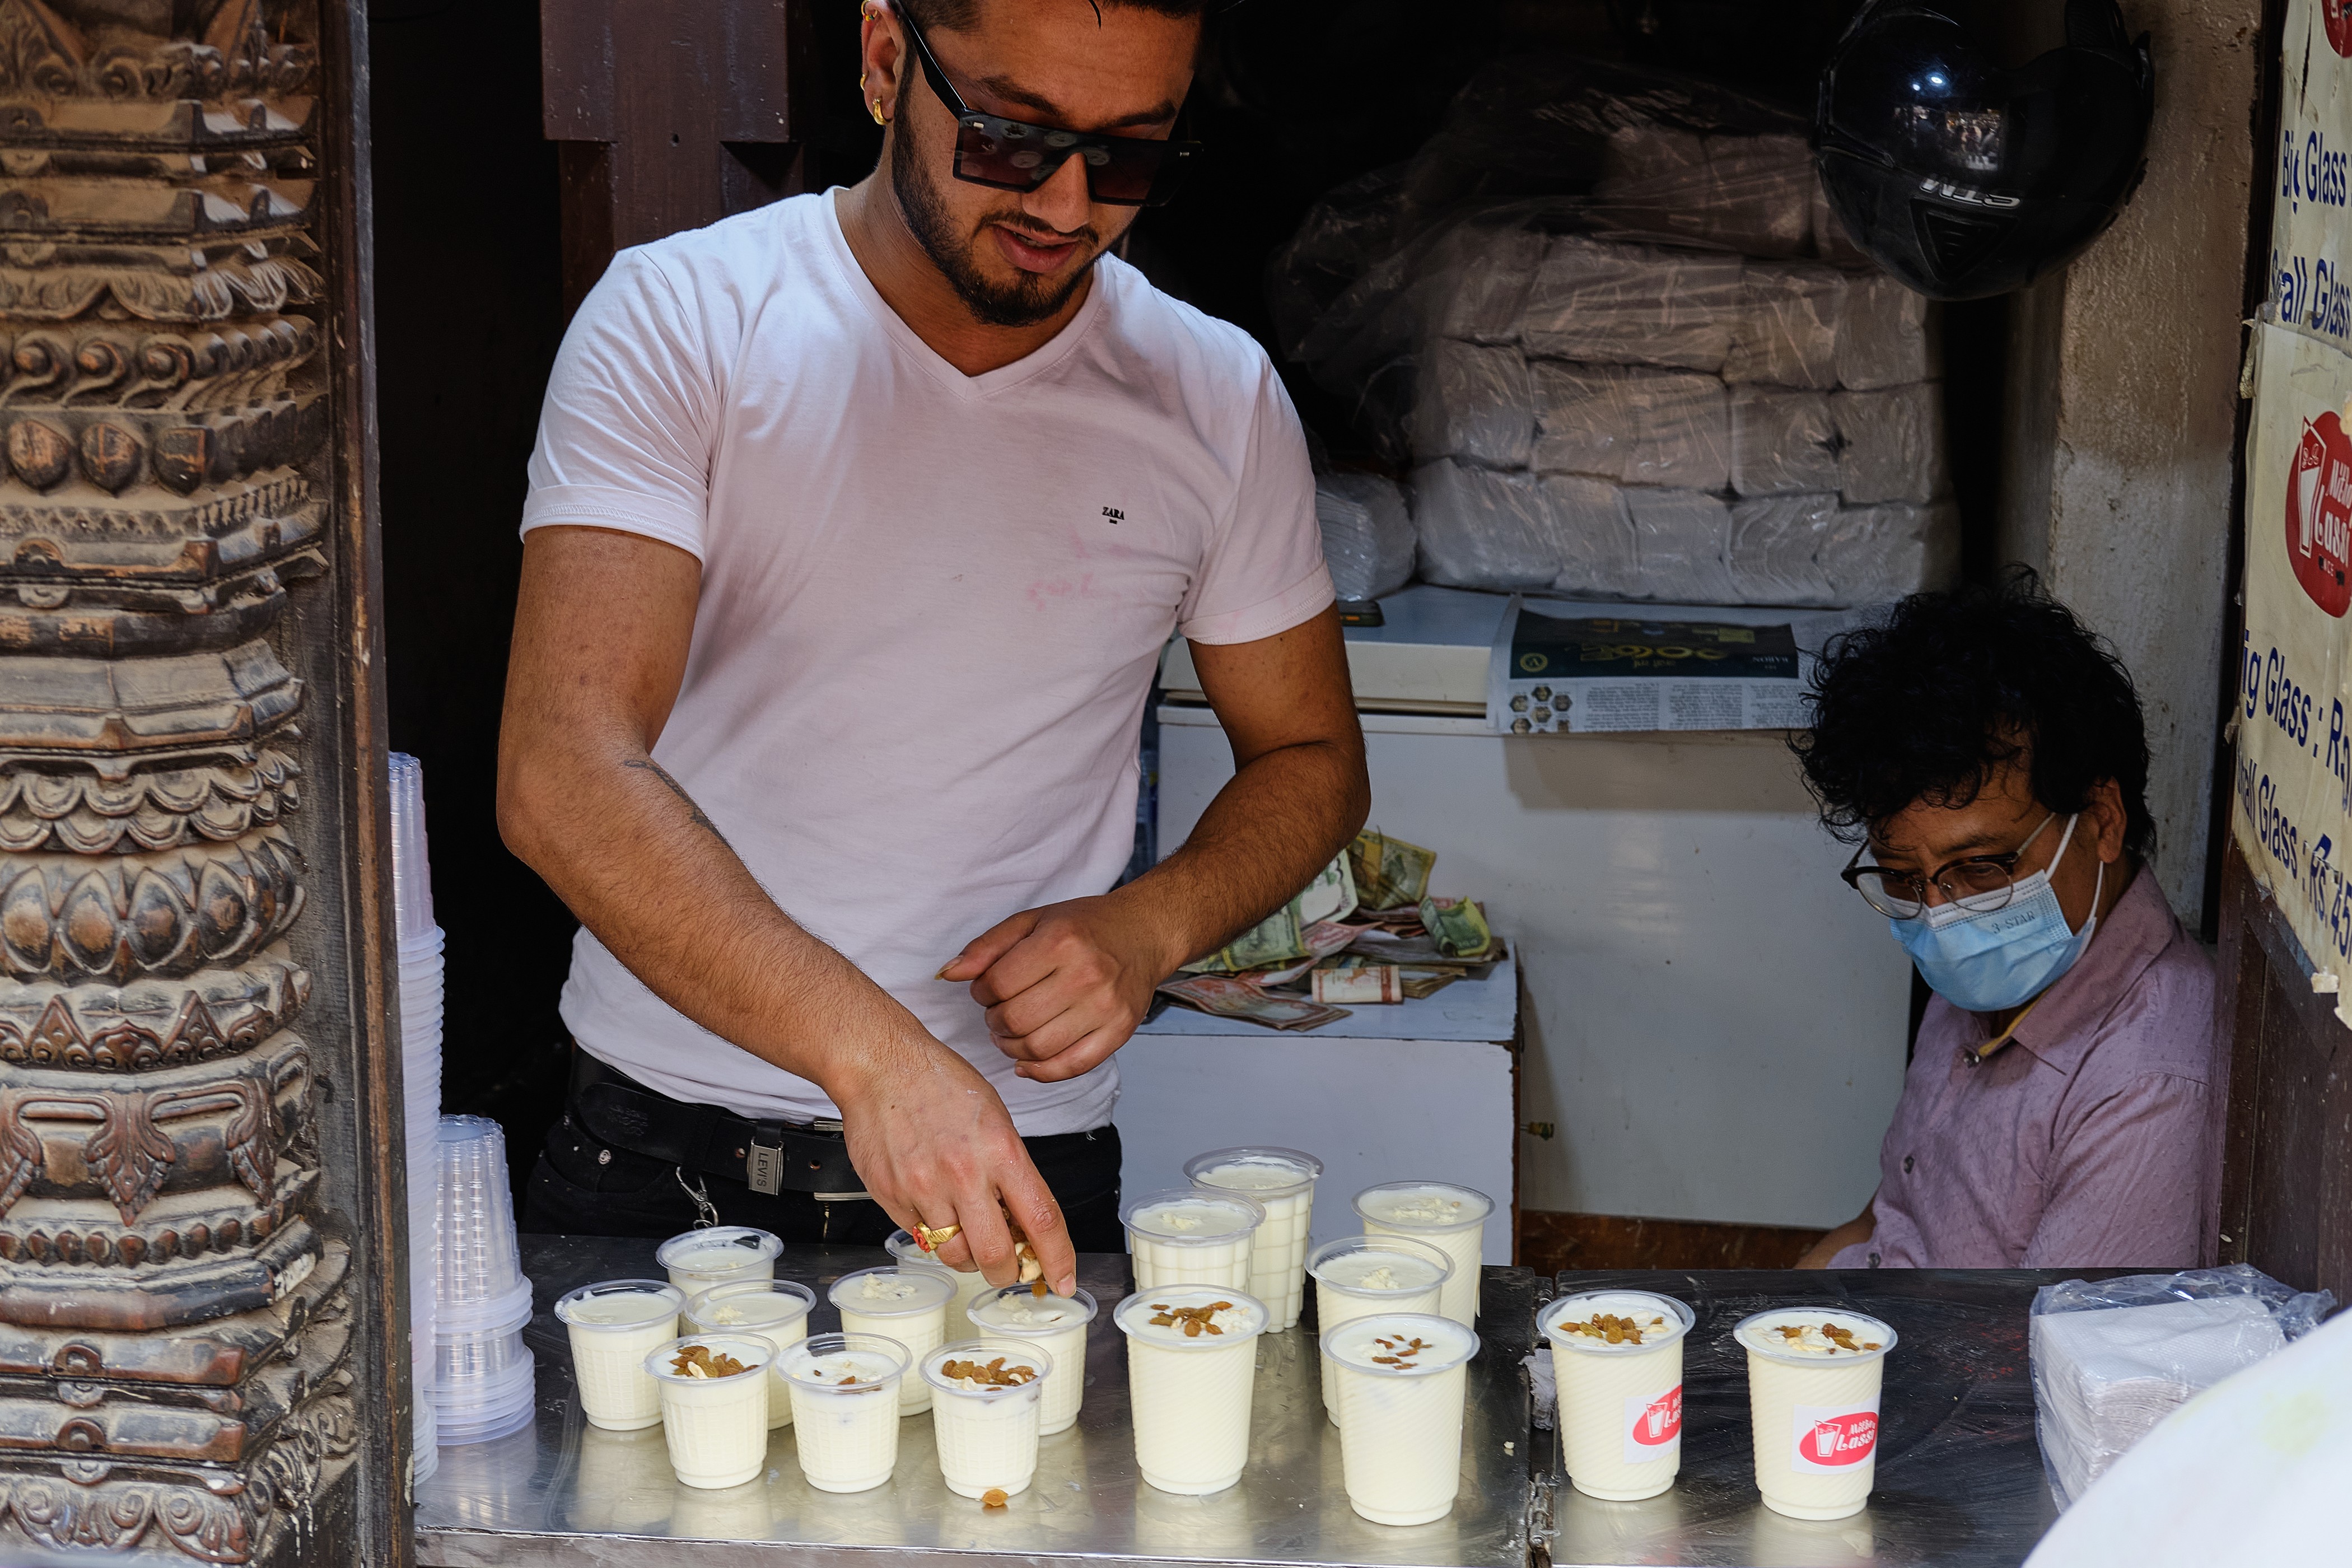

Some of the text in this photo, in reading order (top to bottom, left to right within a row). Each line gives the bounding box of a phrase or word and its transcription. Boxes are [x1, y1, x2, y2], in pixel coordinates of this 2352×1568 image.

[2306, 130, 2347, 207] Glass
[2312, 258, 2351, 340] Glass
[1102, 506, 1125, 521] ZARA
[2314, 484, 2351, 568] Lassi
[2242, 628, 2262, 720] ig
[2265, 646, 2311, 748] Glass
[2258, 774, 2298, 880] Glass
[2005, 910, 2036, 930] STAR
[757, 1152, 769, 1188] LEVI'S
[1835, 1429, 1875, 1452] Lassi
